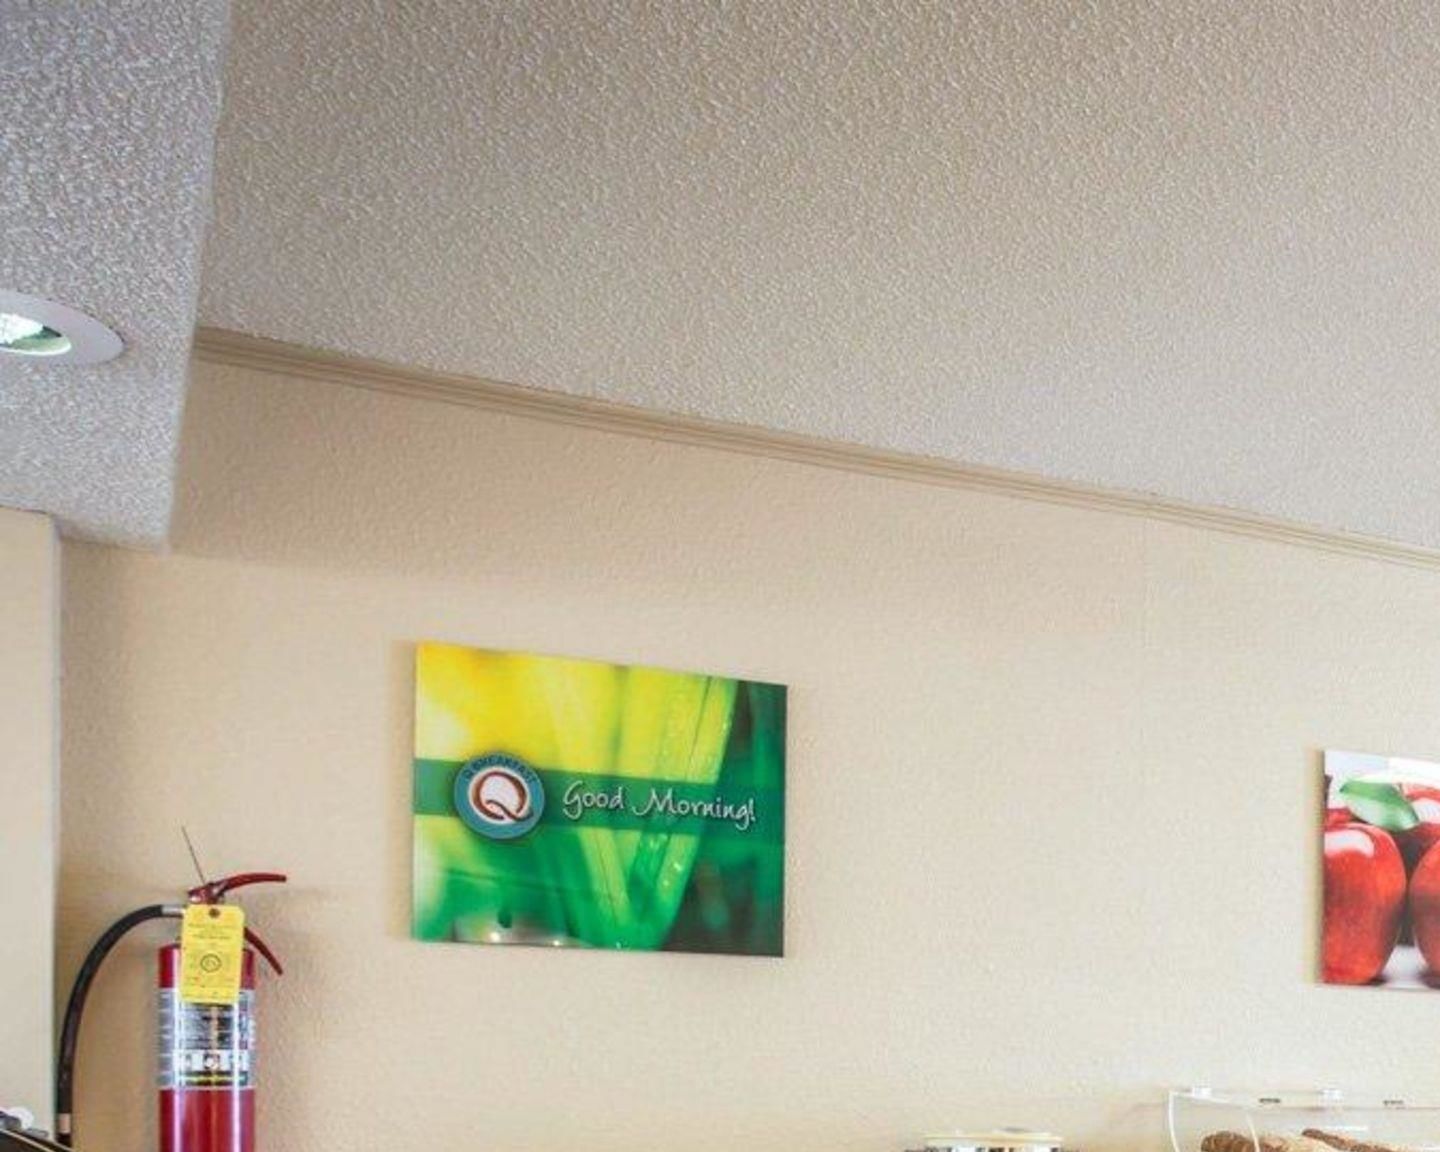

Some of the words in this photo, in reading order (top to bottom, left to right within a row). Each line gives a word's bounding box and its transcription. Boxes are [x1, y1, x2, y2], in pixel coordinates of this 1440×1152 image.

[471, 770, 534, 822] Q
[562, 780, 625, 820] Good
[631, 788, 756, 831] Morning!
